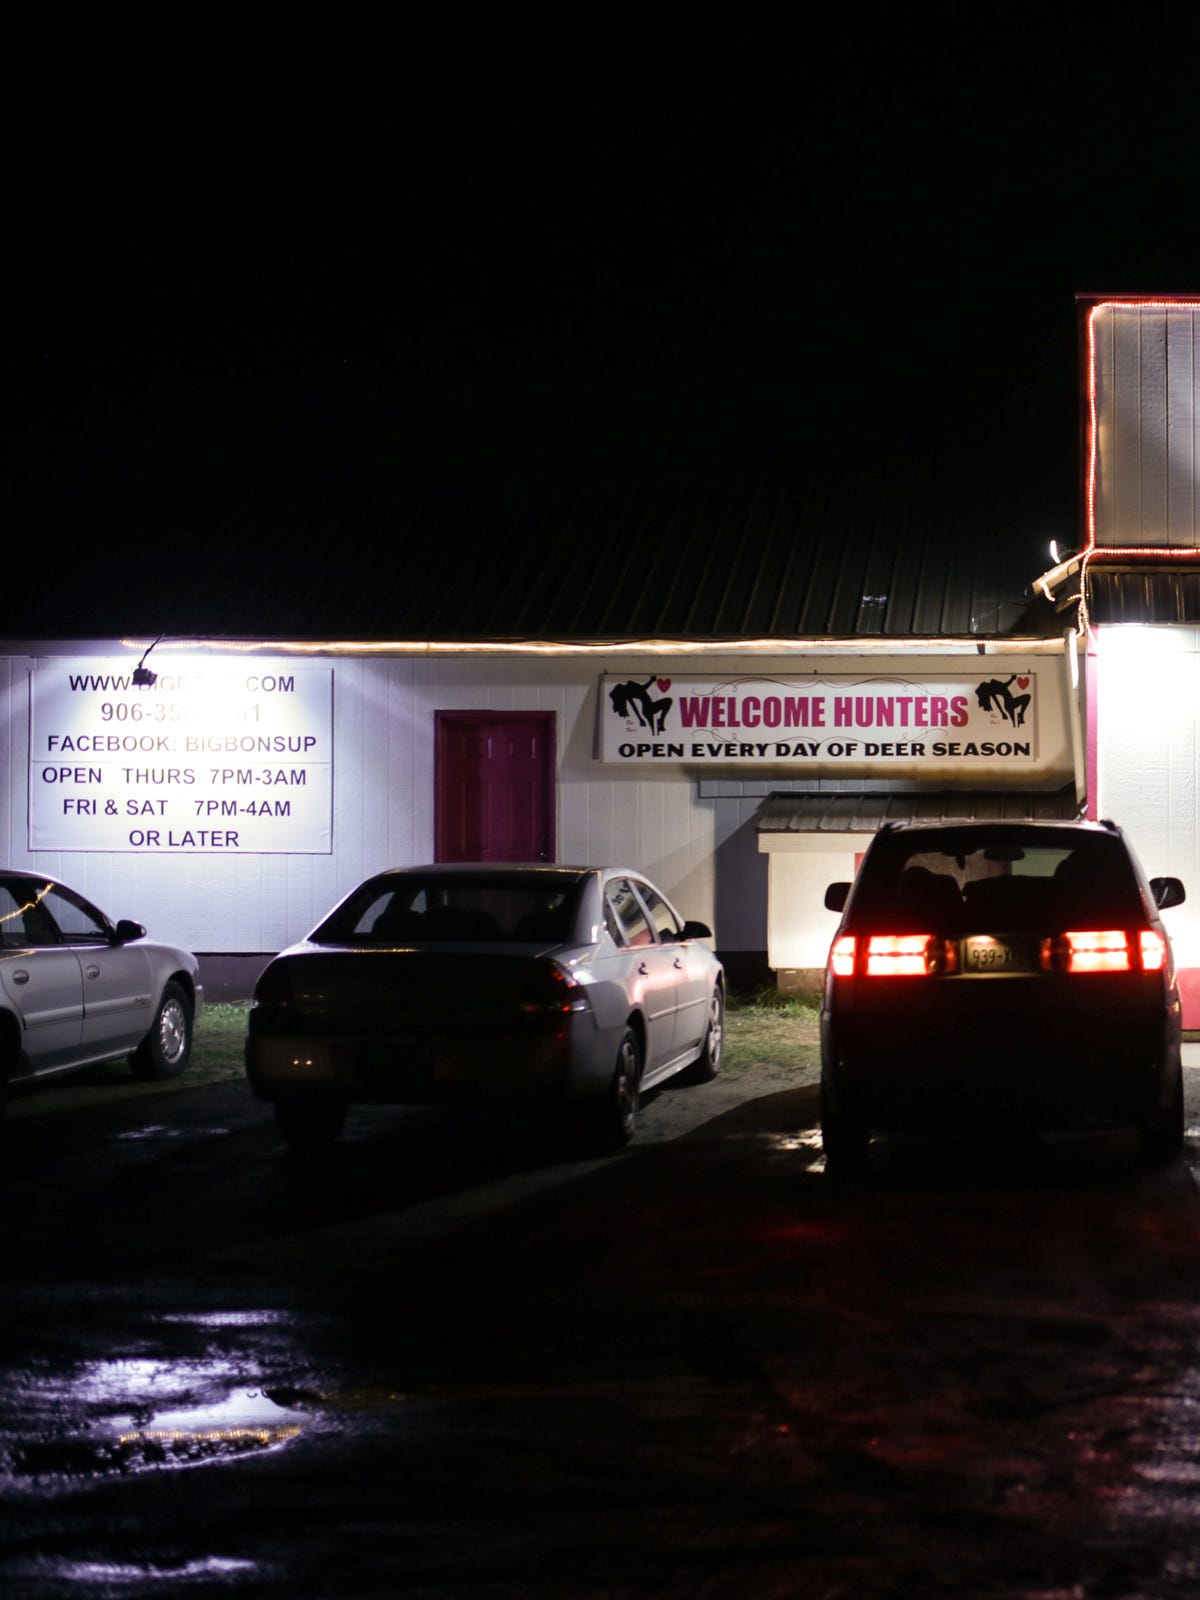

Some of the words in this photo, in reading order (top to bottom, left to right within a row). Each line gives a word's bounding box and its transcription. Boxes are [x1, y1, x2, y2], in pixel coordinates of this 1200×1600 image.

[680, 696, 826, 728] WELCOME
[834, 696, 969, 728] HUNTERS
[185, 736, 317, 752] BIGBONSUP
[618, 743, 684, 758] OPEN
[691, 743, 769, 757] EVERY
[775, 743, 821, 757] DAY
[827, 742, 858, 757] OF
[864, 742, 925, 757] DEER
[932, 742, 1031, 757] SEASON
[42, 767, 102, 784] OPEN
[121, 768, 196, 785] THURS
[209, 769, 307, 786] 7PM-3AM
[63, 799, 97, 815] FRI
[104, 799, 119, 816] &
[126, 799, 169, 816] SAT
[194, 800, 291, 817] 7PM-4AM
[129, 829, 161, 847] OR
[168, 830, 240, 847] LATER
